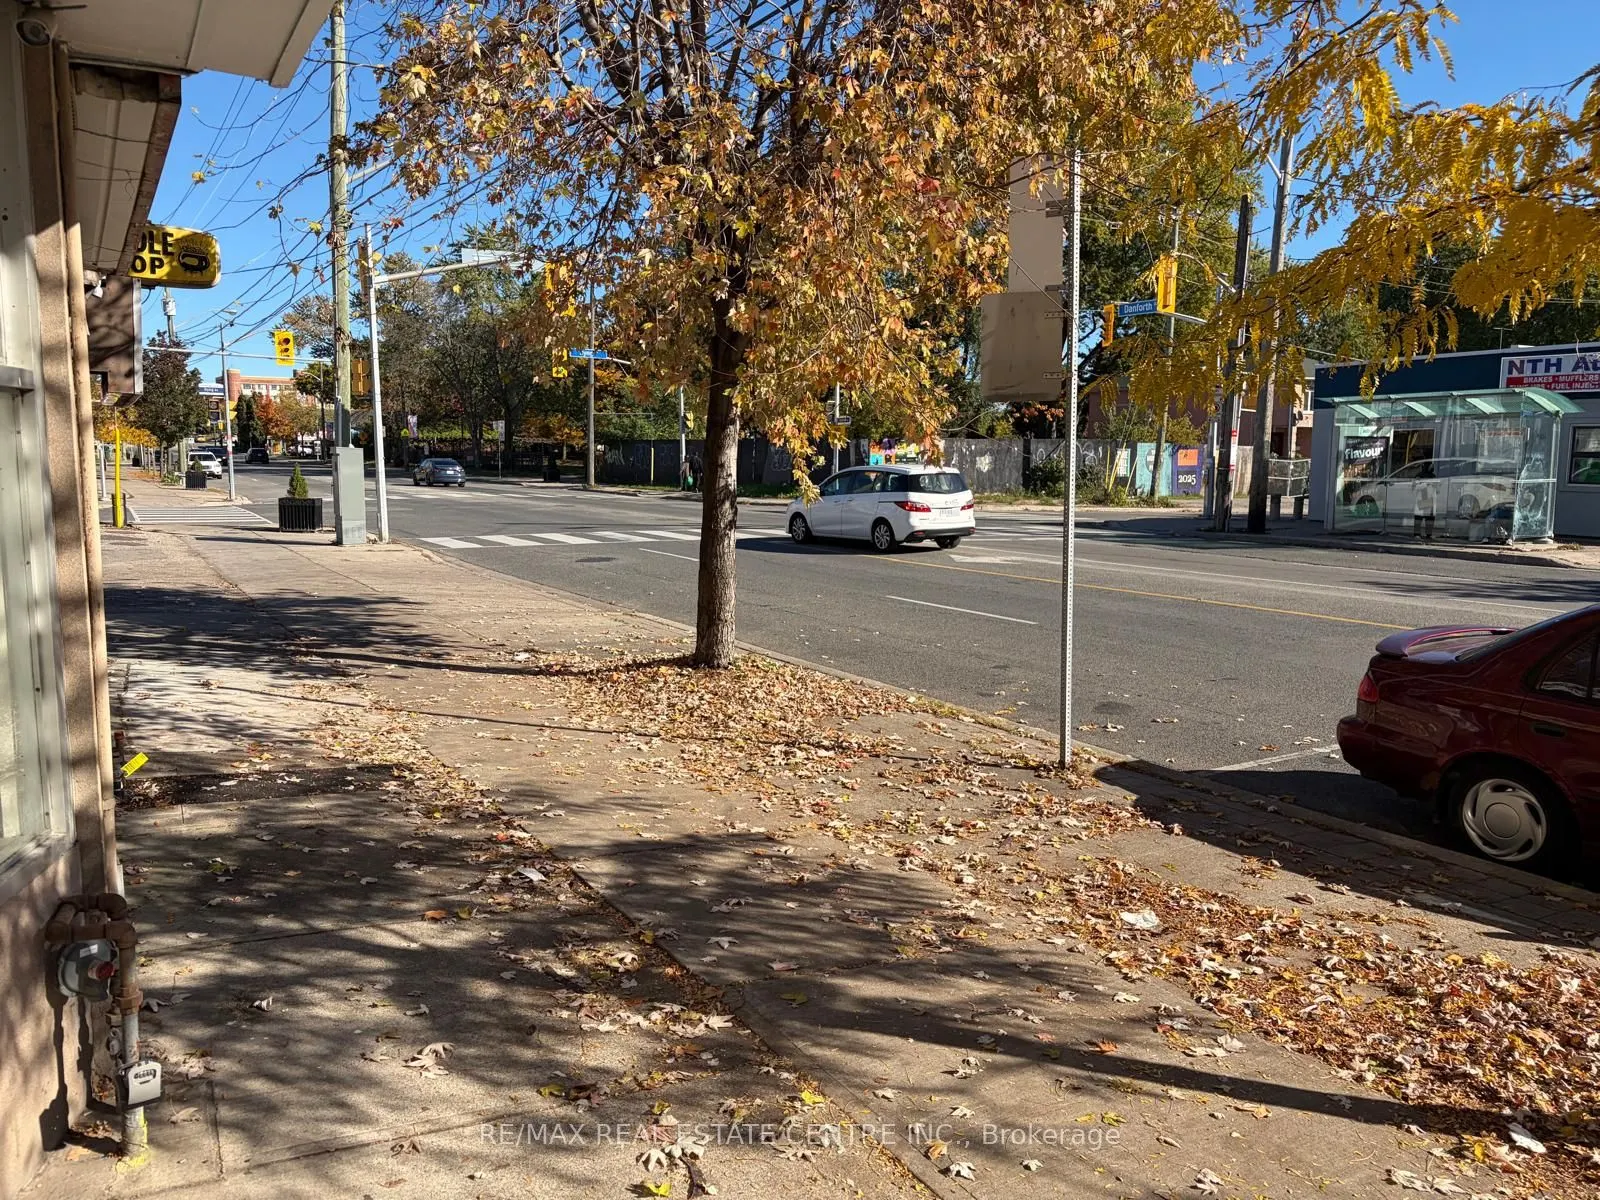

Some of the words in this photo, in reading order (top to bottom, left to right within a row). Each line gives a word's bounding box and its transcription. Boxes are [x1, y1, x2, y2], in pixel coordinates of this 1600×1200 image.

[1124, 303, 1153, 313] Danforth
[1507, 358, 1562, 375] NTH
[1523, 376, 1553, 384] BRAKES
[1558, 374, 1600, 382] MUFFLERS
[1551, 382, 1570, 390] FUEL
[1178, 474, 1196, 485] 2025
